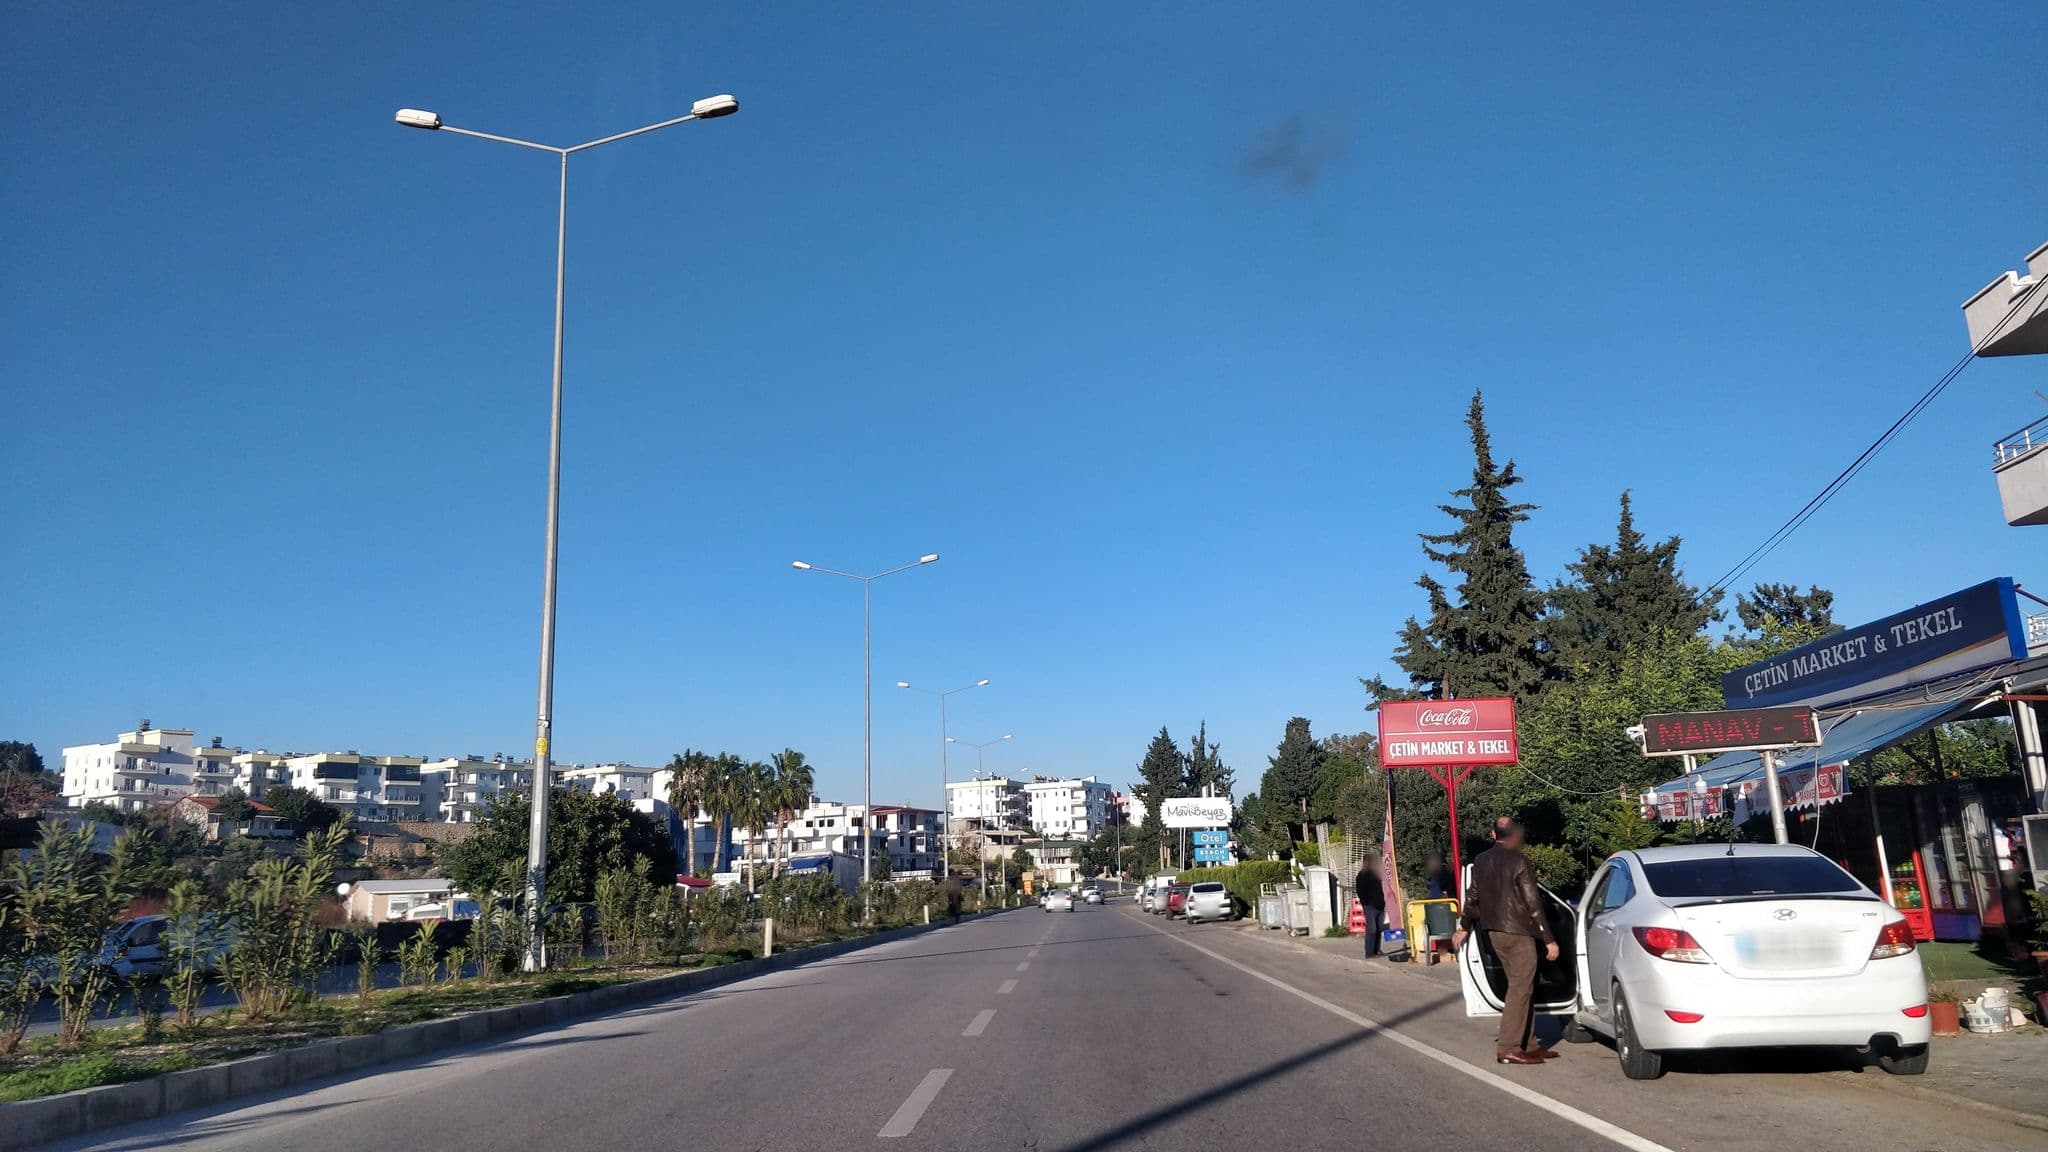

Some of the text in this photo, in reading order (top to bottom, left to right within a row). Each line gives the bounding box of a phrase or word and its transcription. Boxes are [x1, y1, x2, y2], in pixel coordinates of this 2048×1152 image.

[1745, 607, 1963, 699] ÇETİN MARKET & TEKEL
[1420, 708, 1473, 726] Coca-Cola
[1658, 717, 1762, 745] MANAV
[1389, 740, 1510, 758] ÇETİN MARKET & TEKEL
[1200, 833, 1223, 842] Otel
